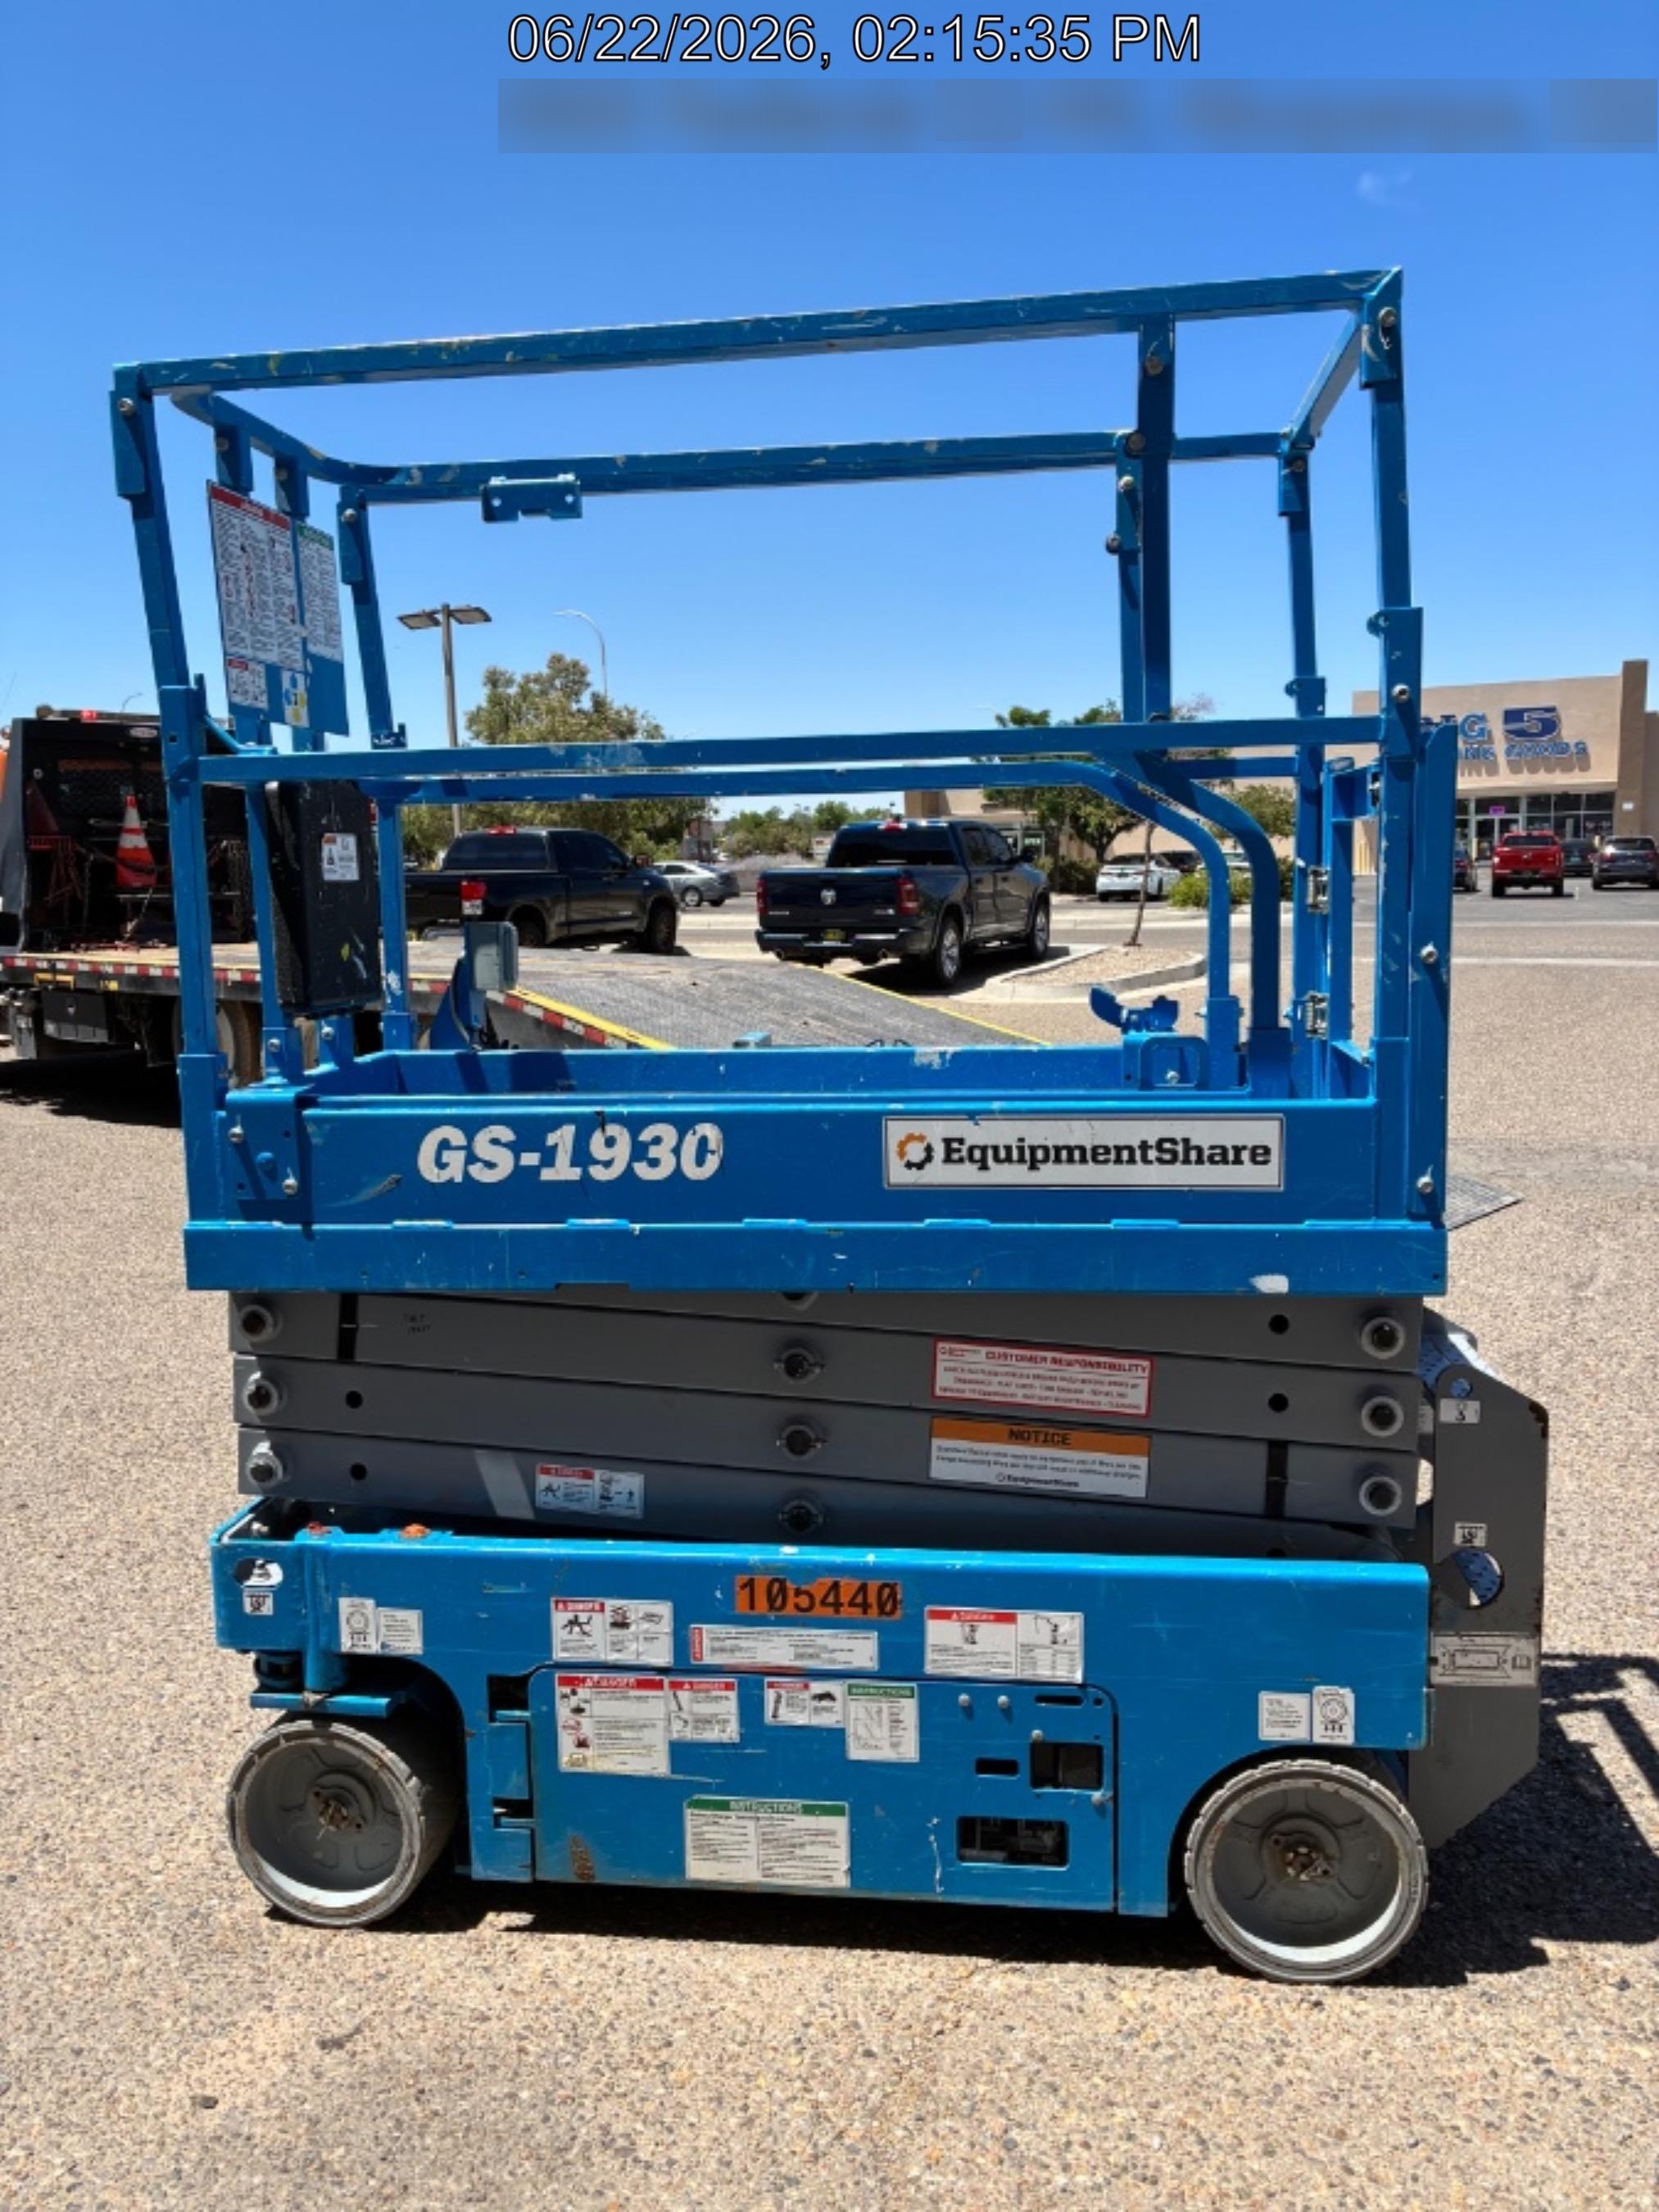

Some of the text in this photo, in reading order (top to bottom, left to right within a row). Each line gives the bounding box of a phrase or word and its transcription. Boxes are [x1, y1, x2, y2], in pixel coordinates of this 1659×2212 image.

[1503, 706, 1560, 741] 5
[1504, 740, 1588, 759] GOODS
[417, 1122, 723, 1182] GS-1930
[941, 1136, 1272, 1171] EquipmentShare
[985, 1351, 1048, 1366] CUSTOMER
[1049, 1356, 1148, 1374] RESPONSIBILITY
[1008, 1428, 1072, 1446] NOTICE
[739, 1576, 899, 1617] 105440
